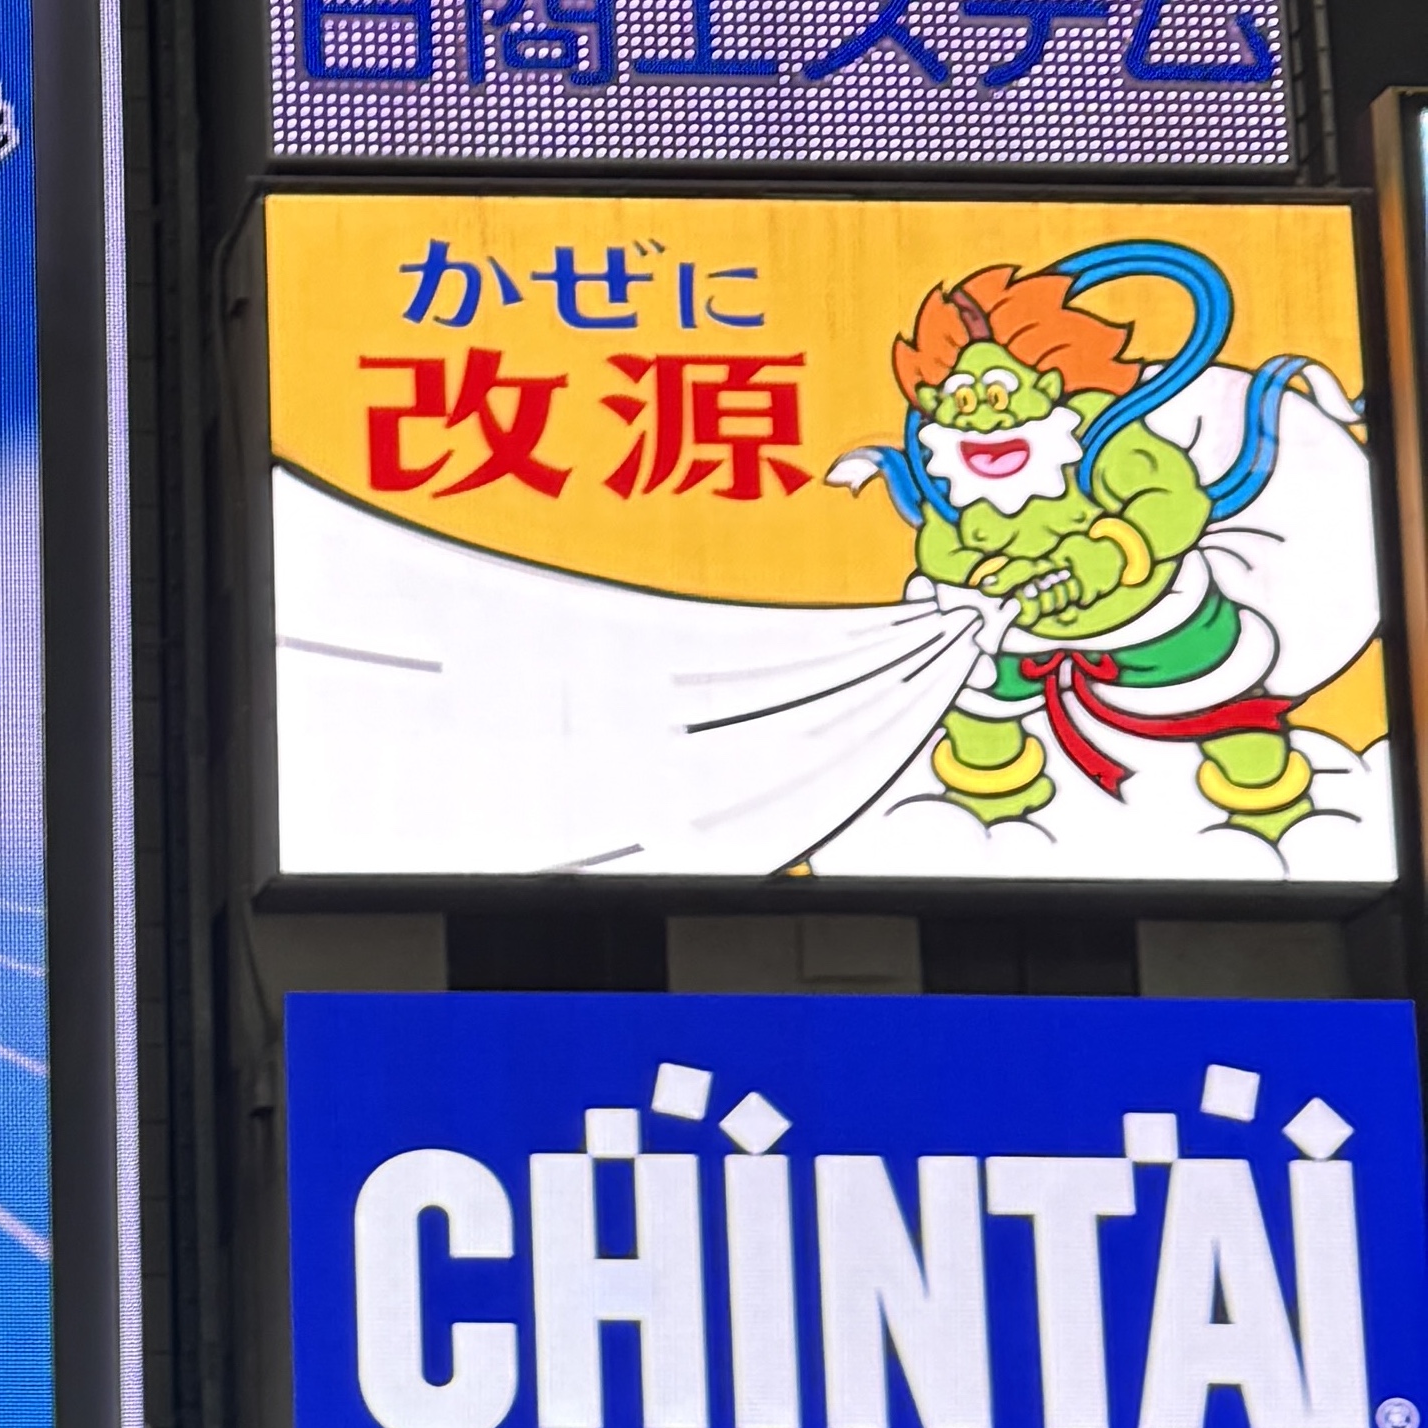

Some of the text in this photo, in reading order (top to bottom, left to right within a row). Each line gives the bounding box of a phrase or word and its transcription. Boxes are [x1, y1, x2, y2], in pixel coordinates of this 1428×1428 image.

[399, 238, 768, 331] かぜに
[357, 347, 814, 500] 改源
